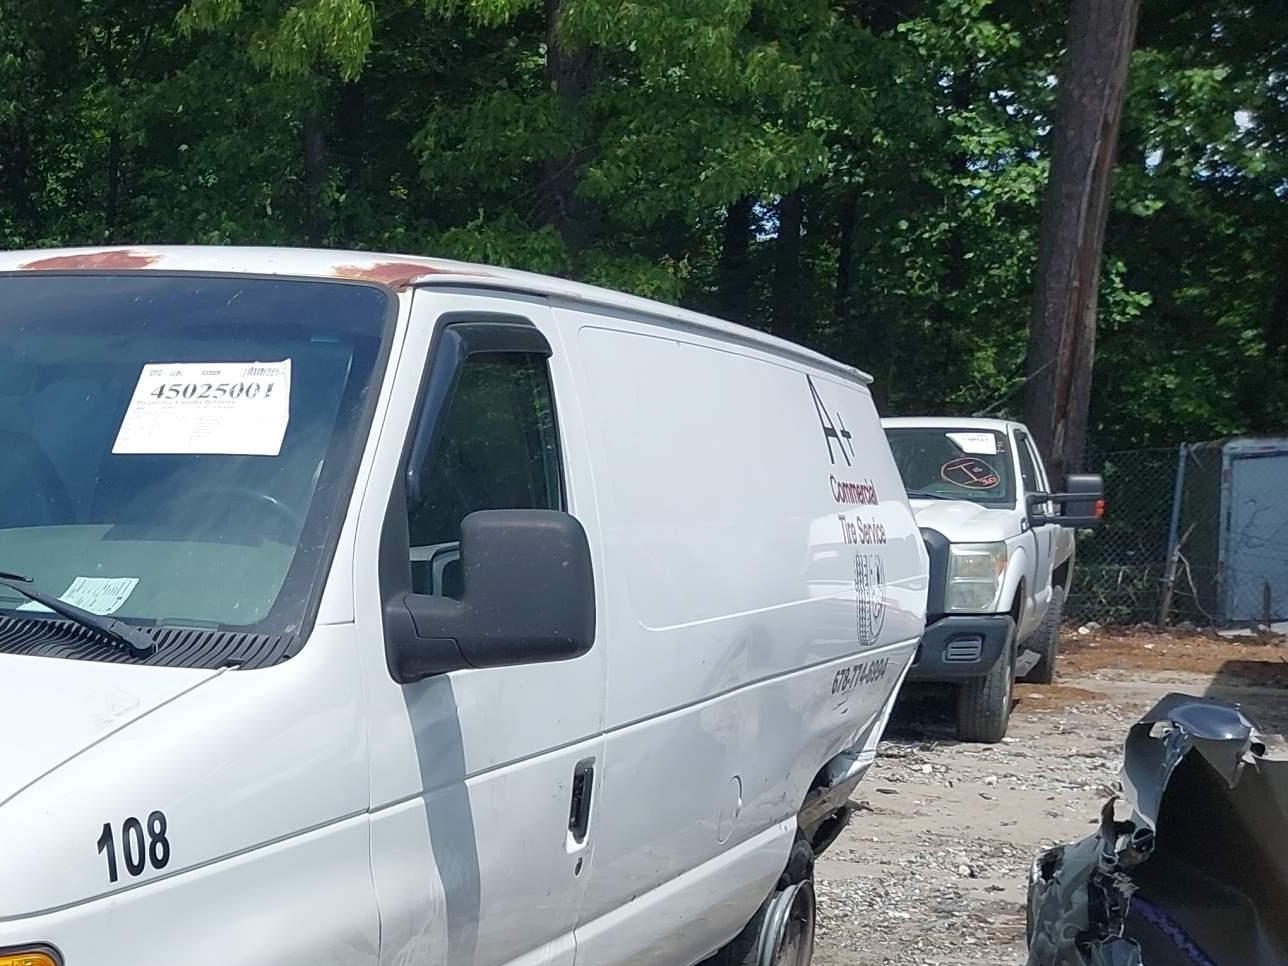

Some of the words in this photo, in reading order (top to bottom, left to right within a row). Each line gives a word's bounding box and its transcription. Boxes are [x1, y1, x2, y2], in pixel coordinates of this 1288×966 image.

[150, 381, 275, 400] 45025001
[829, 474, 879, 506] Commercial
[838, 514, 857, 545] Tire
[857, 515, 887, 545] Service
[96, 810, 170, 883] 108
